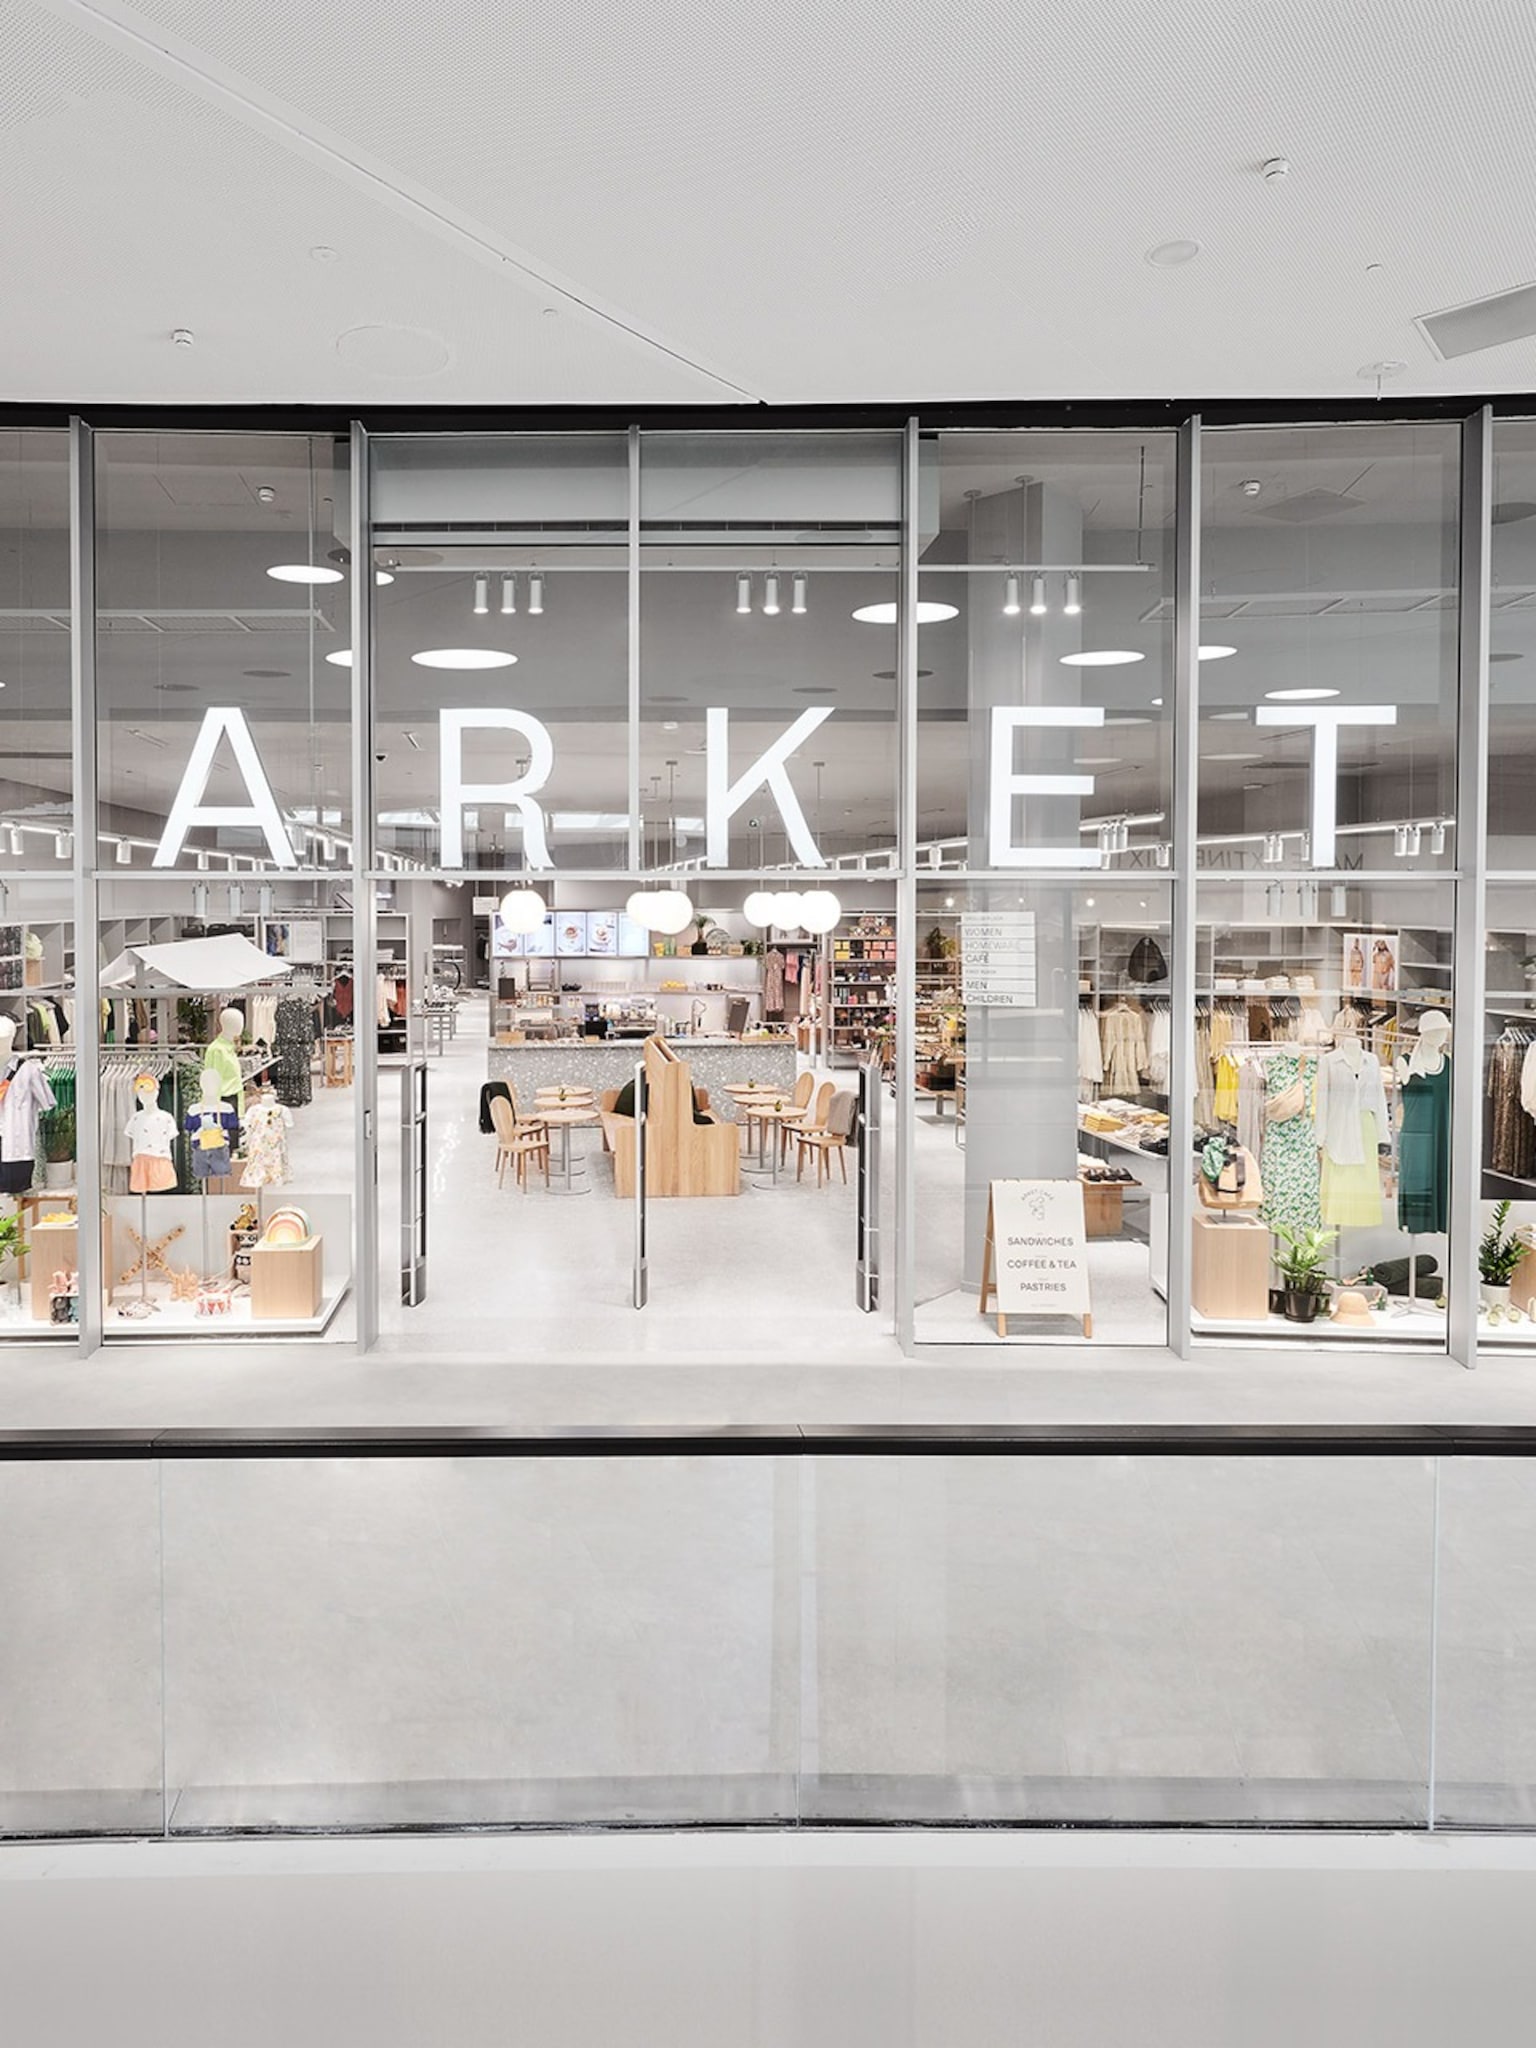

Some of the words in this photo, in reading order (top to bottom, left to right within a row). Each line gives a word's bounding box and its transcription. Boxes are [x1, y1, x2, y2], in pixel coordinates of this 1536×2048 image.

[151, 705, 1398, 870] ARKET
[964, 927, 1002, 937] WOMEN
[966, 980, 988, 990] MEN
[966, 994, 1013, 1003] CHILDREN
[1007, 1236, 1074, 1247] SANDWICHES
[1007, 1259, 1047, 1269] COFFEE
[1049, 1259, 1056, 1269] &
[1057, 1260, 1077, 1269] TEA
[1020, 1282, 1066, 1292] PASTRIES
